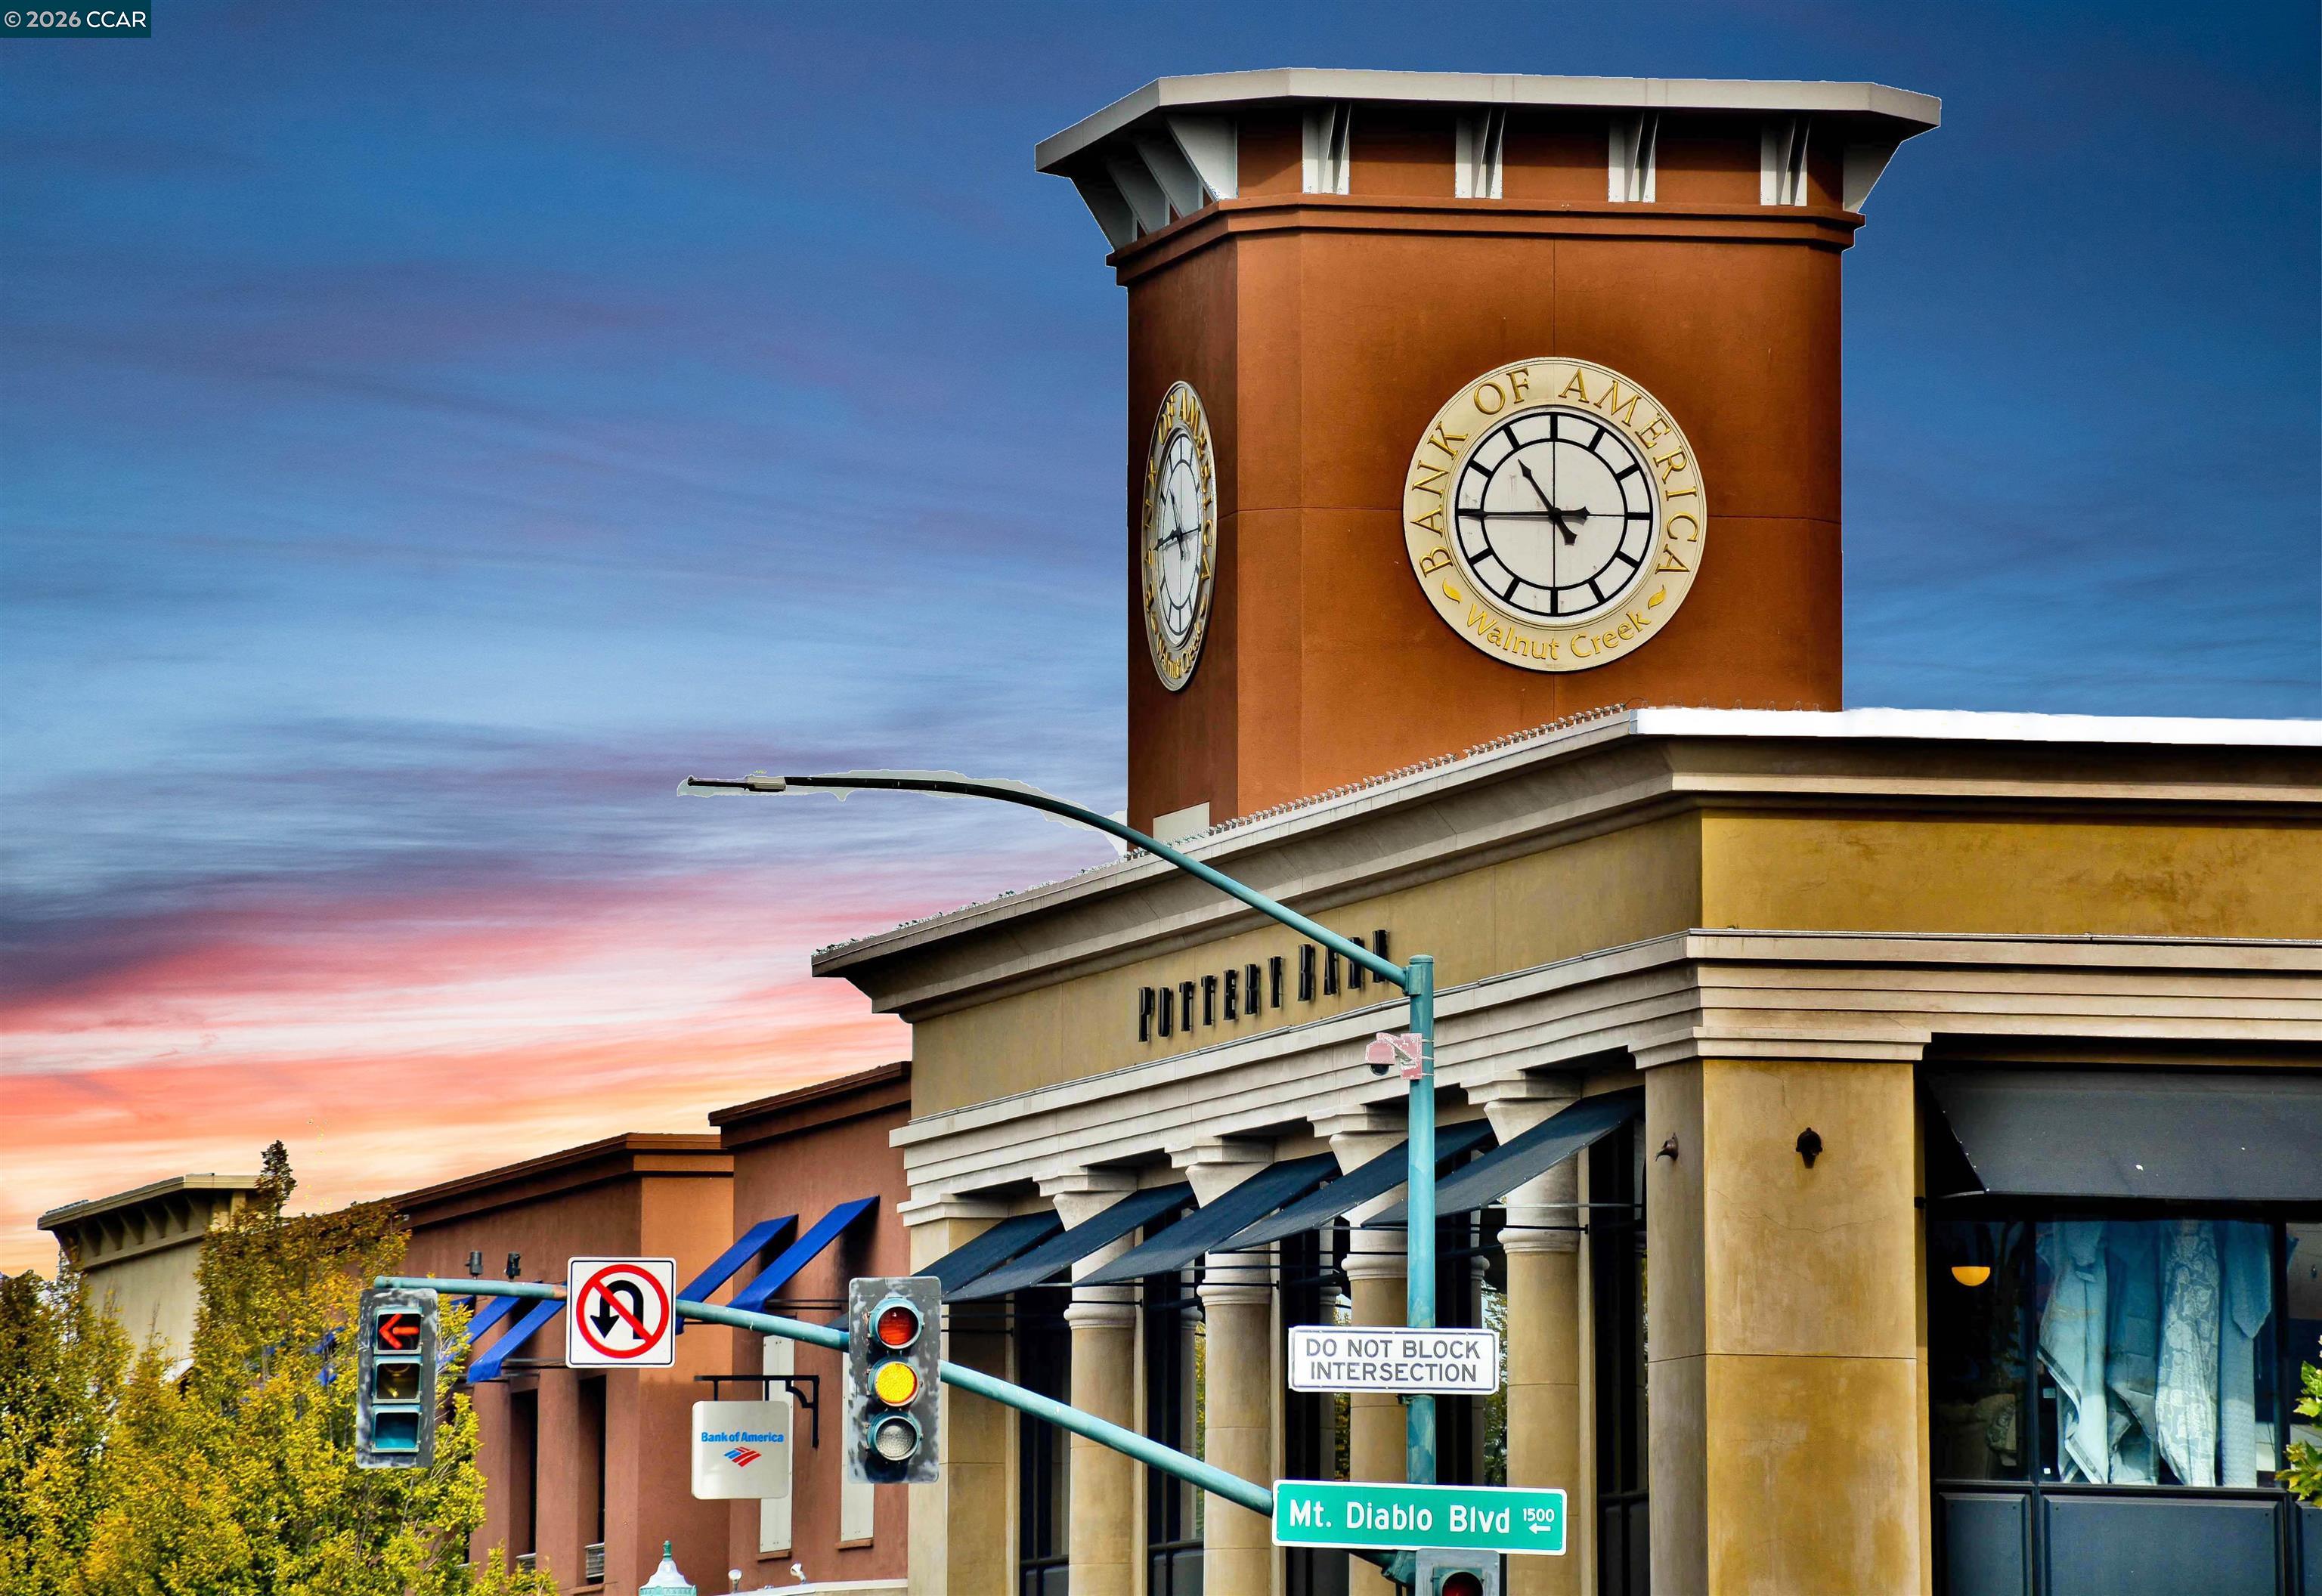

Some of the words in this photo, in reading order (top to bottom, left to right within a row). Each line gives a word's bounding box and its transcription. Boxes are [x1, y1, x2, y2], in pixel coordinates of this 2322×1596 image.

[1158, 394, 1175, 446] OF
[1410, 421, 1469, 578] BANK
[1474, 367, 1531, 415] OF
[1558, 367, 1698, 574] AMERICA
[1156, 633, 1181, 679] Walnut
[1181, 621, 1203, 673] Creek
[1466, 602, 1560, 660] Walnut
[1570, 611, 1652, 658] Creek
[1138, 954, 1286, 1042] POTTERY
[1306, 1338, 1337, 1357] DO
[1348, 1338, 1392, 1358] NOT
[1403, 1339, 1481, 1359] BLOCK
[1311, 1361, 1476, 1382] INTERSECTION
[701, 1431, 728, 1443] Bank
[729, 1431, 741, 1443] of
[741, 1431, 785, 1443] America
[1289, 1499, 1333, 1528] Mt.
[1346, 1501, 1433, 1532] Diablo
[1450, 1505, 1510, 1534] Blvd
[1522, 1507, 1556, 1523] 1500
